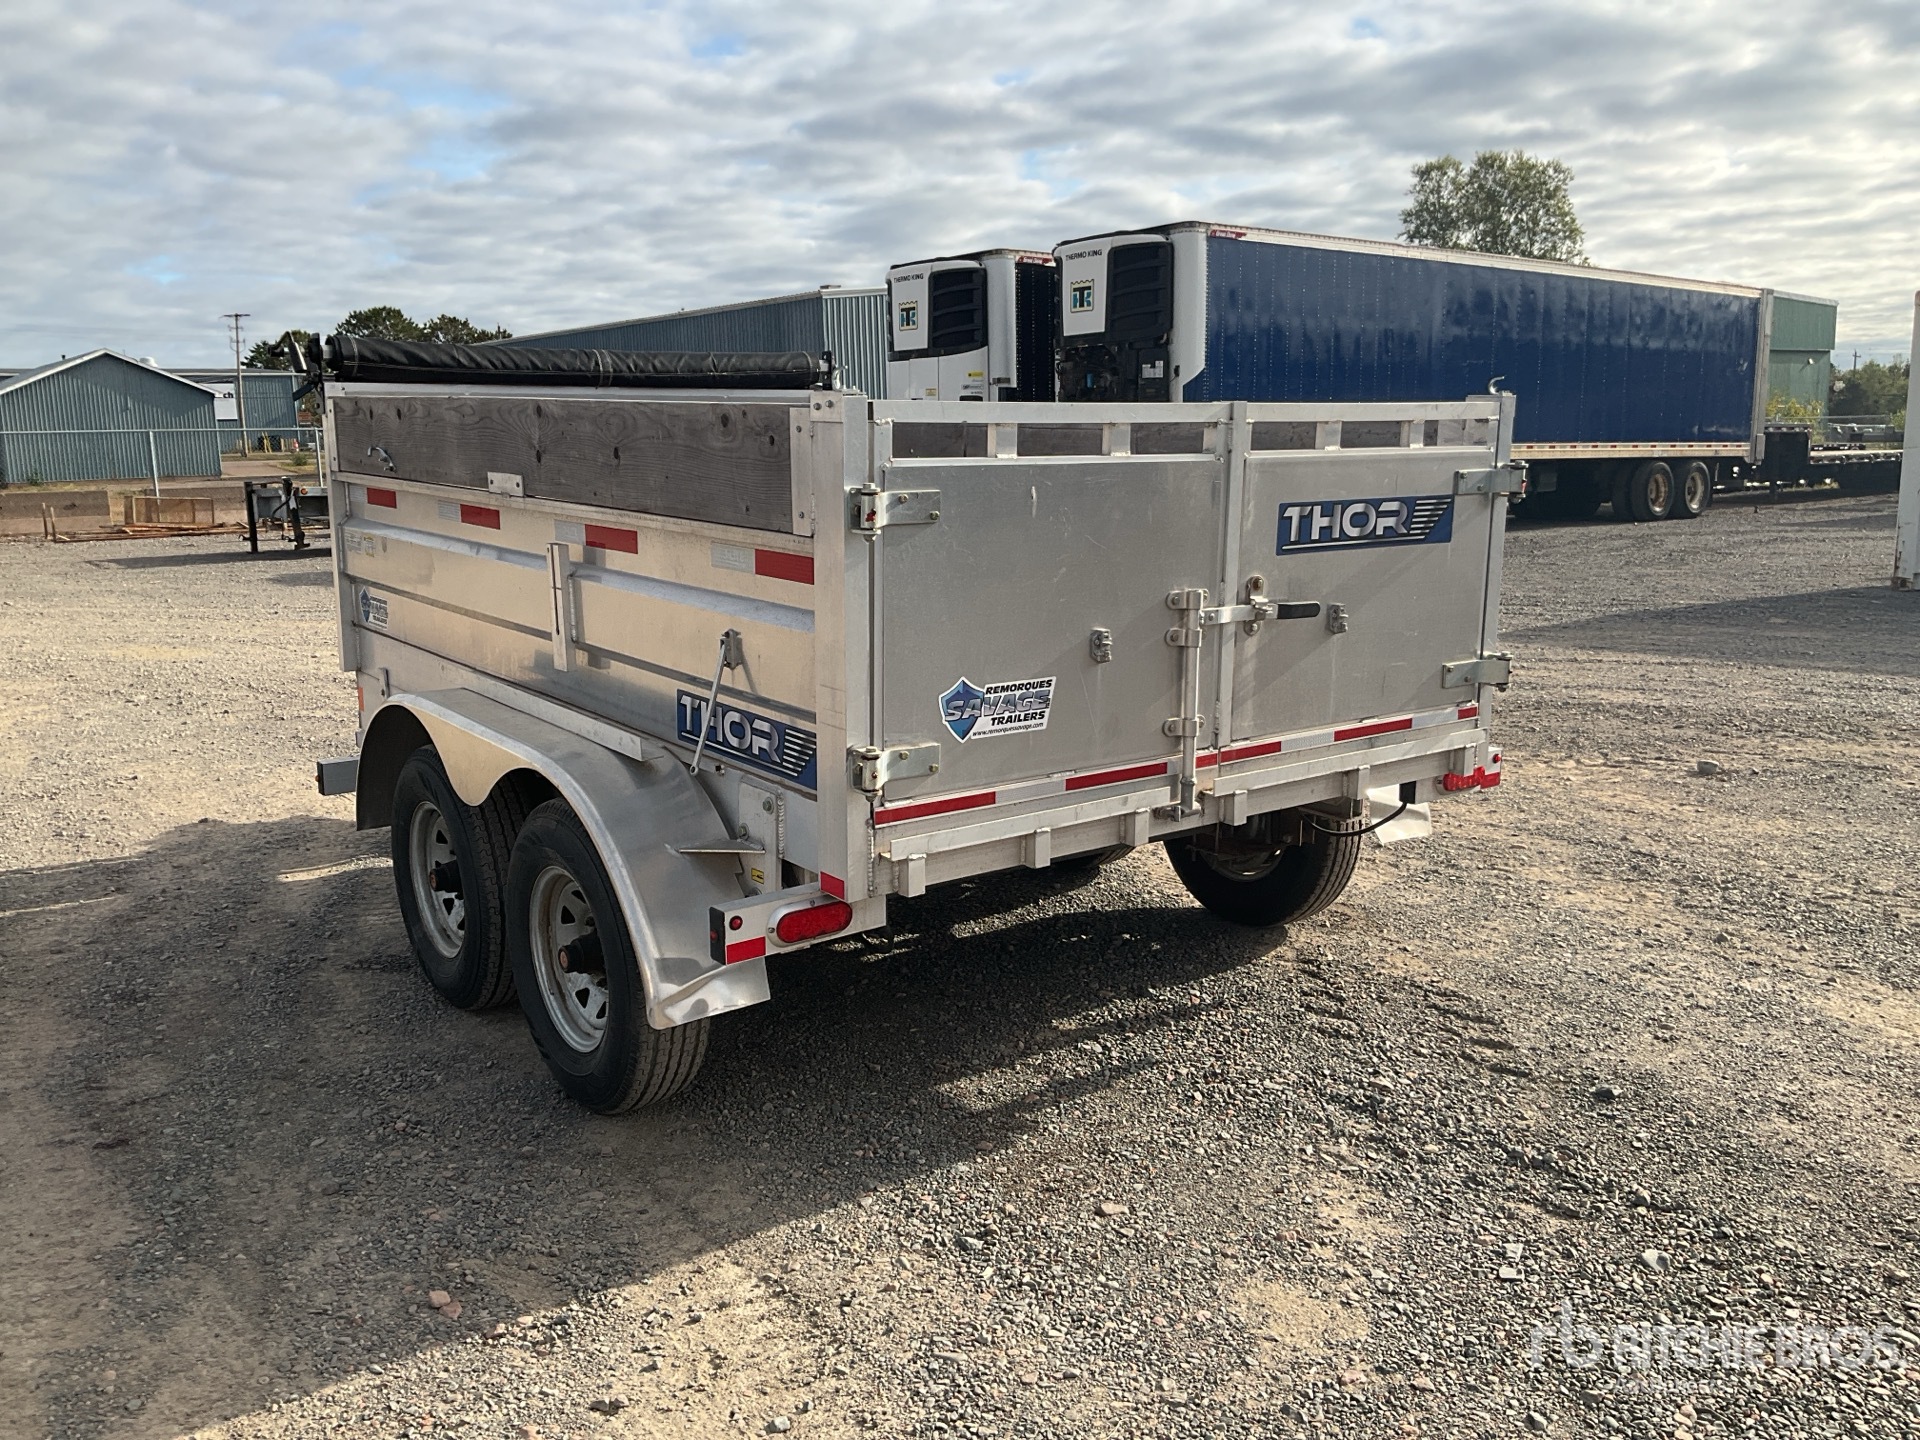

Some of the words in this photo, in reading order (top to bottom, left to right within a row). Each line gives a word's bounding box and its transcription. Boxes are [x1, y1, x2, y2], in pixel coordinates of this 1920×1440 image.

[1065, 251, 1087, 261] THERMO
[1088, 249, 1102, 257] KING
[894, 275, 911, 283] THERMO
[1283, 500, 1409, 542] THOR
[985, 679, 1053, 695] REMORQUES
[944, 690, 1052, 722] SAVAGE
[990, 711, 1046, 726] TRAILERS
[680, 694, 781, 764] THOR
